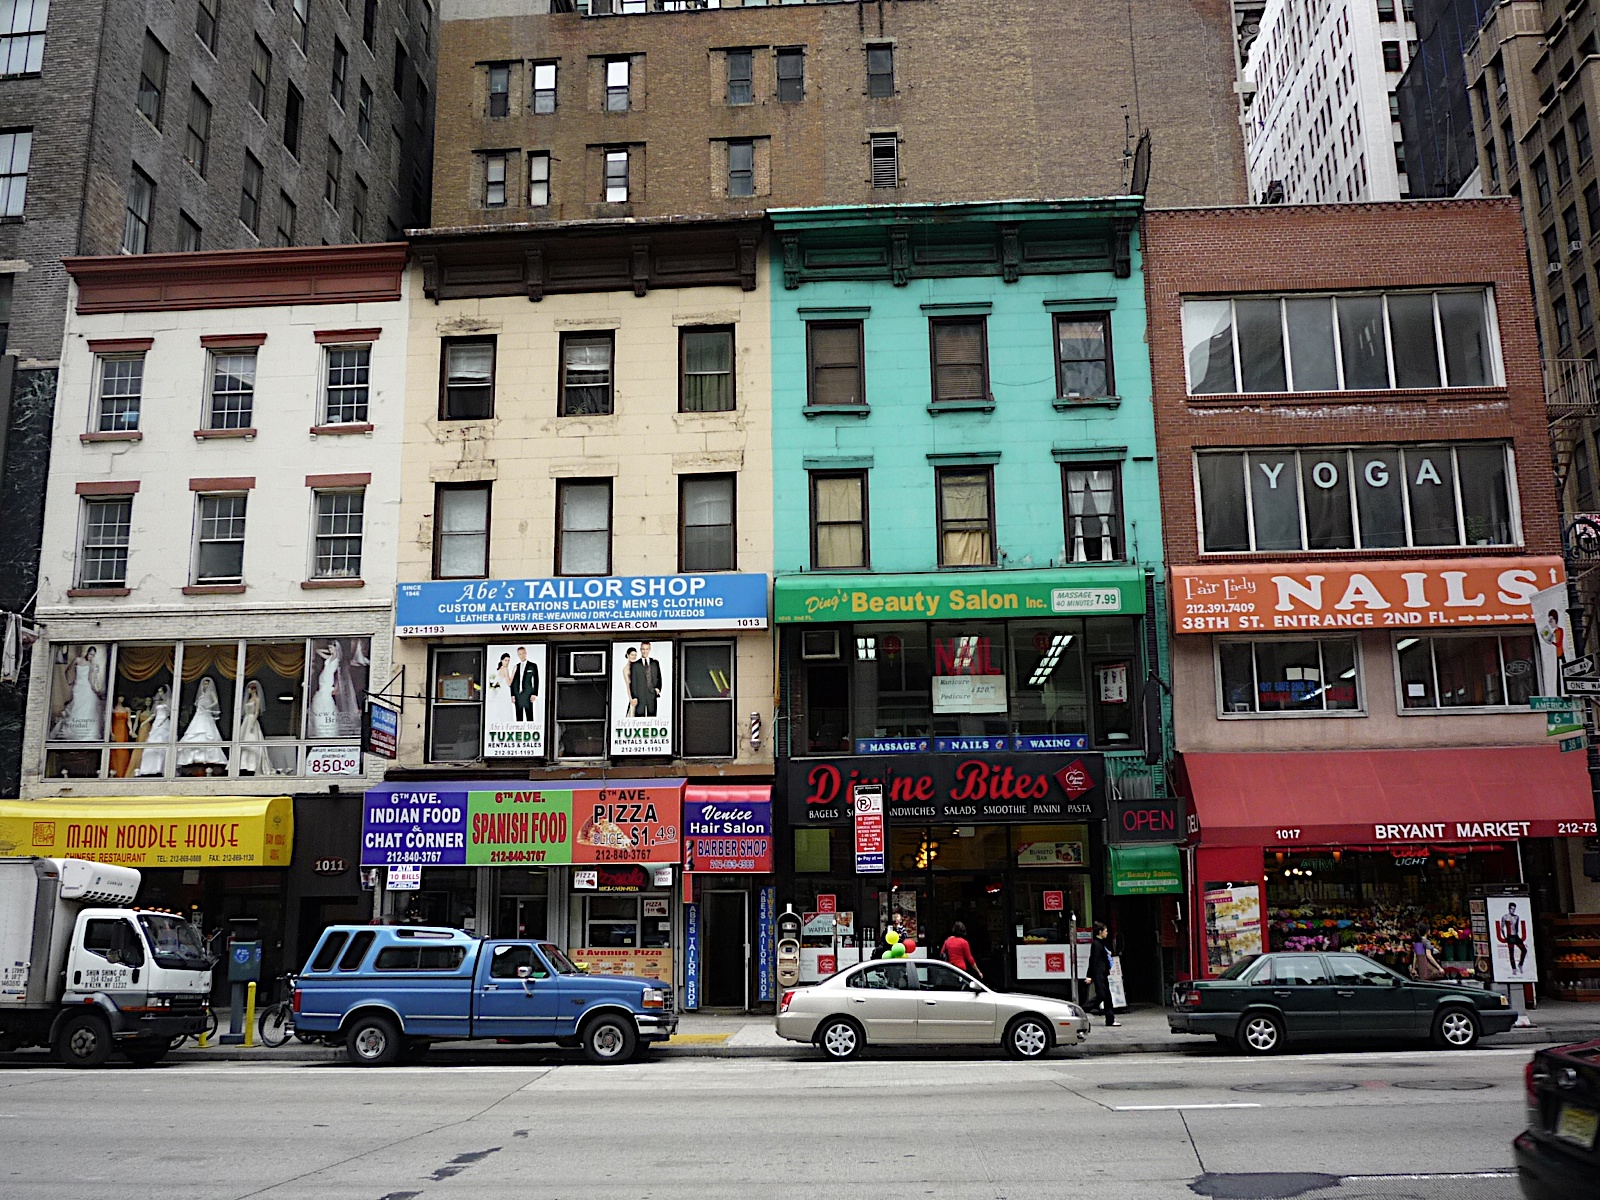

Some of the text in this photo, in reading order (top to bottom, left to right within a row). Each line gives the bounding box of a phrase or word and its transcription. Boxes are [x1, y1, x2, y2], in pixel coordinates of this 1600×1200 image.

[1259, 458, 1442, 489] YOGA
[456, 577, 706, 602] Abe's TAILOR SHOP
[1183, 569, 1539, 612] Fair Lady NAILS
[438, 597, 724, 613] CUSTOM ALTERATIONS LADIES' MEN'S CLOTHING
[805, 589, 1048, 617] Ding's Beauty Salon Inc.
[1095, 594, 1117, 605] 7.99
[455, 608, 705, 623] LEATHER & FURS RE-WEAVING DRY-CLEANING TUXEDOS
[1186, 603, 1256, 614] 212.391.7409
[402, 618, 761, 634] 921-1193 WWW.ABESFORMALWEAR.COM 1013
[1182, 611, 1455, 630] 38TH ST. ENTRANCE 2ND FL.
[934, 636, 1001, 676] NAIL
[1570, 680, 1600, 690] ONE WA
[1535, 702, 1573, 710] AMERICAS
[1554, 712, 1562, 724] 6
[490, 731, 541, 742] TUXEDO
[616, 728, 668, 738] TUXEDO
[869, 742, 917, 752] MASSAGE
[951, 740, 990, 750] NAILS
[1029, 738, 1071, 748] WAXING
[1568, 740, 1577, 750] 38
[805, 758, 1049, 805] Dine Bites
[391, 793, 442, 804] 6TH AVE.
[495, 791, 546, 803] 6TH AVE.
[599, 789, 651, 801] 6TH AVE.
[370, 807, 461, 823] INDIAN FOOD
[593, 803, 658, 823] PIZZA
[701, 804, 753, 821] Venice
[809, 809, 839, 819] BAGELS
[890, 806, 936, 817] ANDWICHES
[944, 805, 977, 816] SALADS
[983, 804, 1027, 815] SMOOTHIE
[1033, 804, 1061, 814] PANINI
[1068, 803, 1092, 813] PASTA
[472, 811, 568, 844] SPANISH FOOD
[690, 822, 764, 834] Hair Salon
[1122, 810, 1175, 831] OPEN
[66, 825, 108, 848] MAIN
[116, 824, 178, 848] NOODLE
[184, 823, 240, 848] HOUSE
[593, 826, 678, 847] SLICE $1.49
[1276, 829, 1301, 839] 1017
[1375, 823, 1446, 840] BRYANT
[1456, 821, 1531, 838] MARKET
[365, 832, 464, 848] CHAT CORNER
[595, 849, 651, 861] 212-840-3767
[698, 839, 767, 857] BARBER SHOP
[64, 852, 96, 863] CHINESE
[98, 852, 147, 863] RESTAURANT
[387, 851, 442, 862] 212-840-3767
[490, 850, 547, 862] 212-840-3767
[1395, 857, 1428, 867] LIGHT
[315, 860, 344, 871] 1011
[1300, 858, 1335, 872] ATM
[760, 923, 768, 965] TAILOR
[688, 937, 697, 976] TAILOR
[86, 969, 100, 977] SHUN
[101, 968, 117, 976] SHING
[760, 970, 768, 999] SHOP
[687, 980, 696, 1007] SHOP
